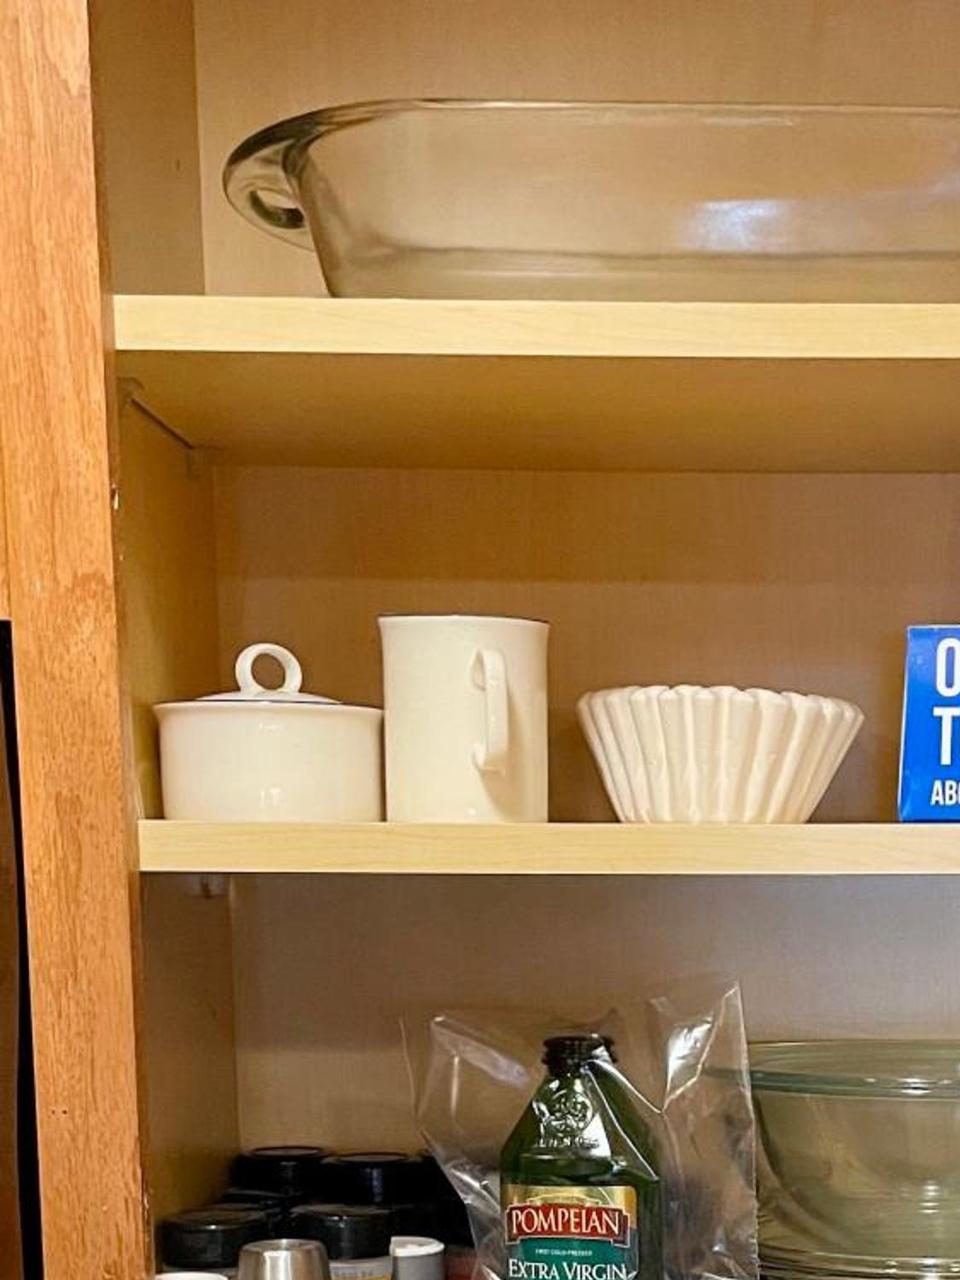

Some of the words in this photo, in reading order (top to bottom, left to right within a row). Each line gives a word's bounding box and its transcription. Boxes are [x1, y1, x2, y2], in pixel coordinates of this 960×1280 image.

[511, 1208, 619, 1235] POMPEIAN
[509, 1258, 560, 1280] EXTRA
[562, 1262, 626, 1280] VIRGIN
